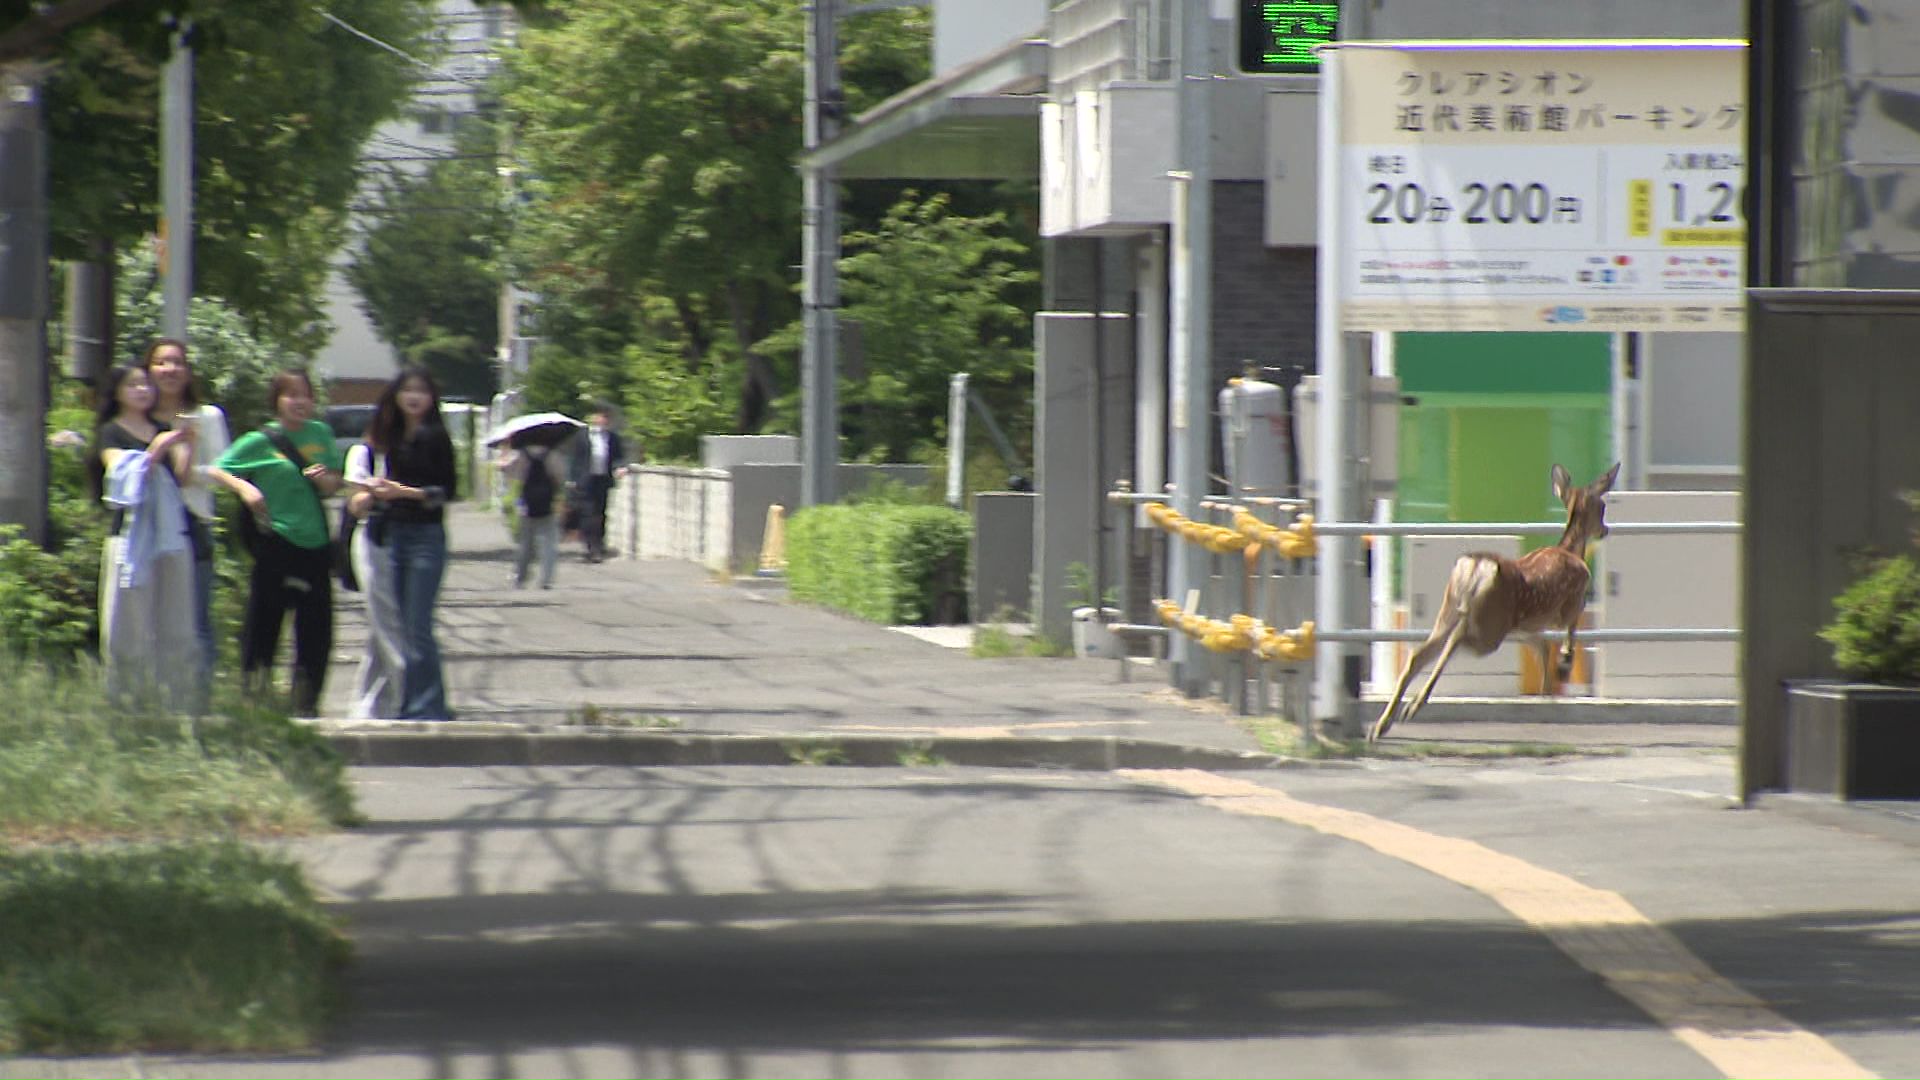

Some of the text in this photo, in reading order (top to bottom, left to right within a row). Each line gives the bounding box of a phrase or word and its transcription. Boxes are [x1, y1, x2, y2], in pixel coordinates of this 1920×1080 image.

[1397, 71, 1594, 95] クレアシオン
[1367, 182, 1453, 224] 20分
[1461, 182, 1582, 224] 200円
